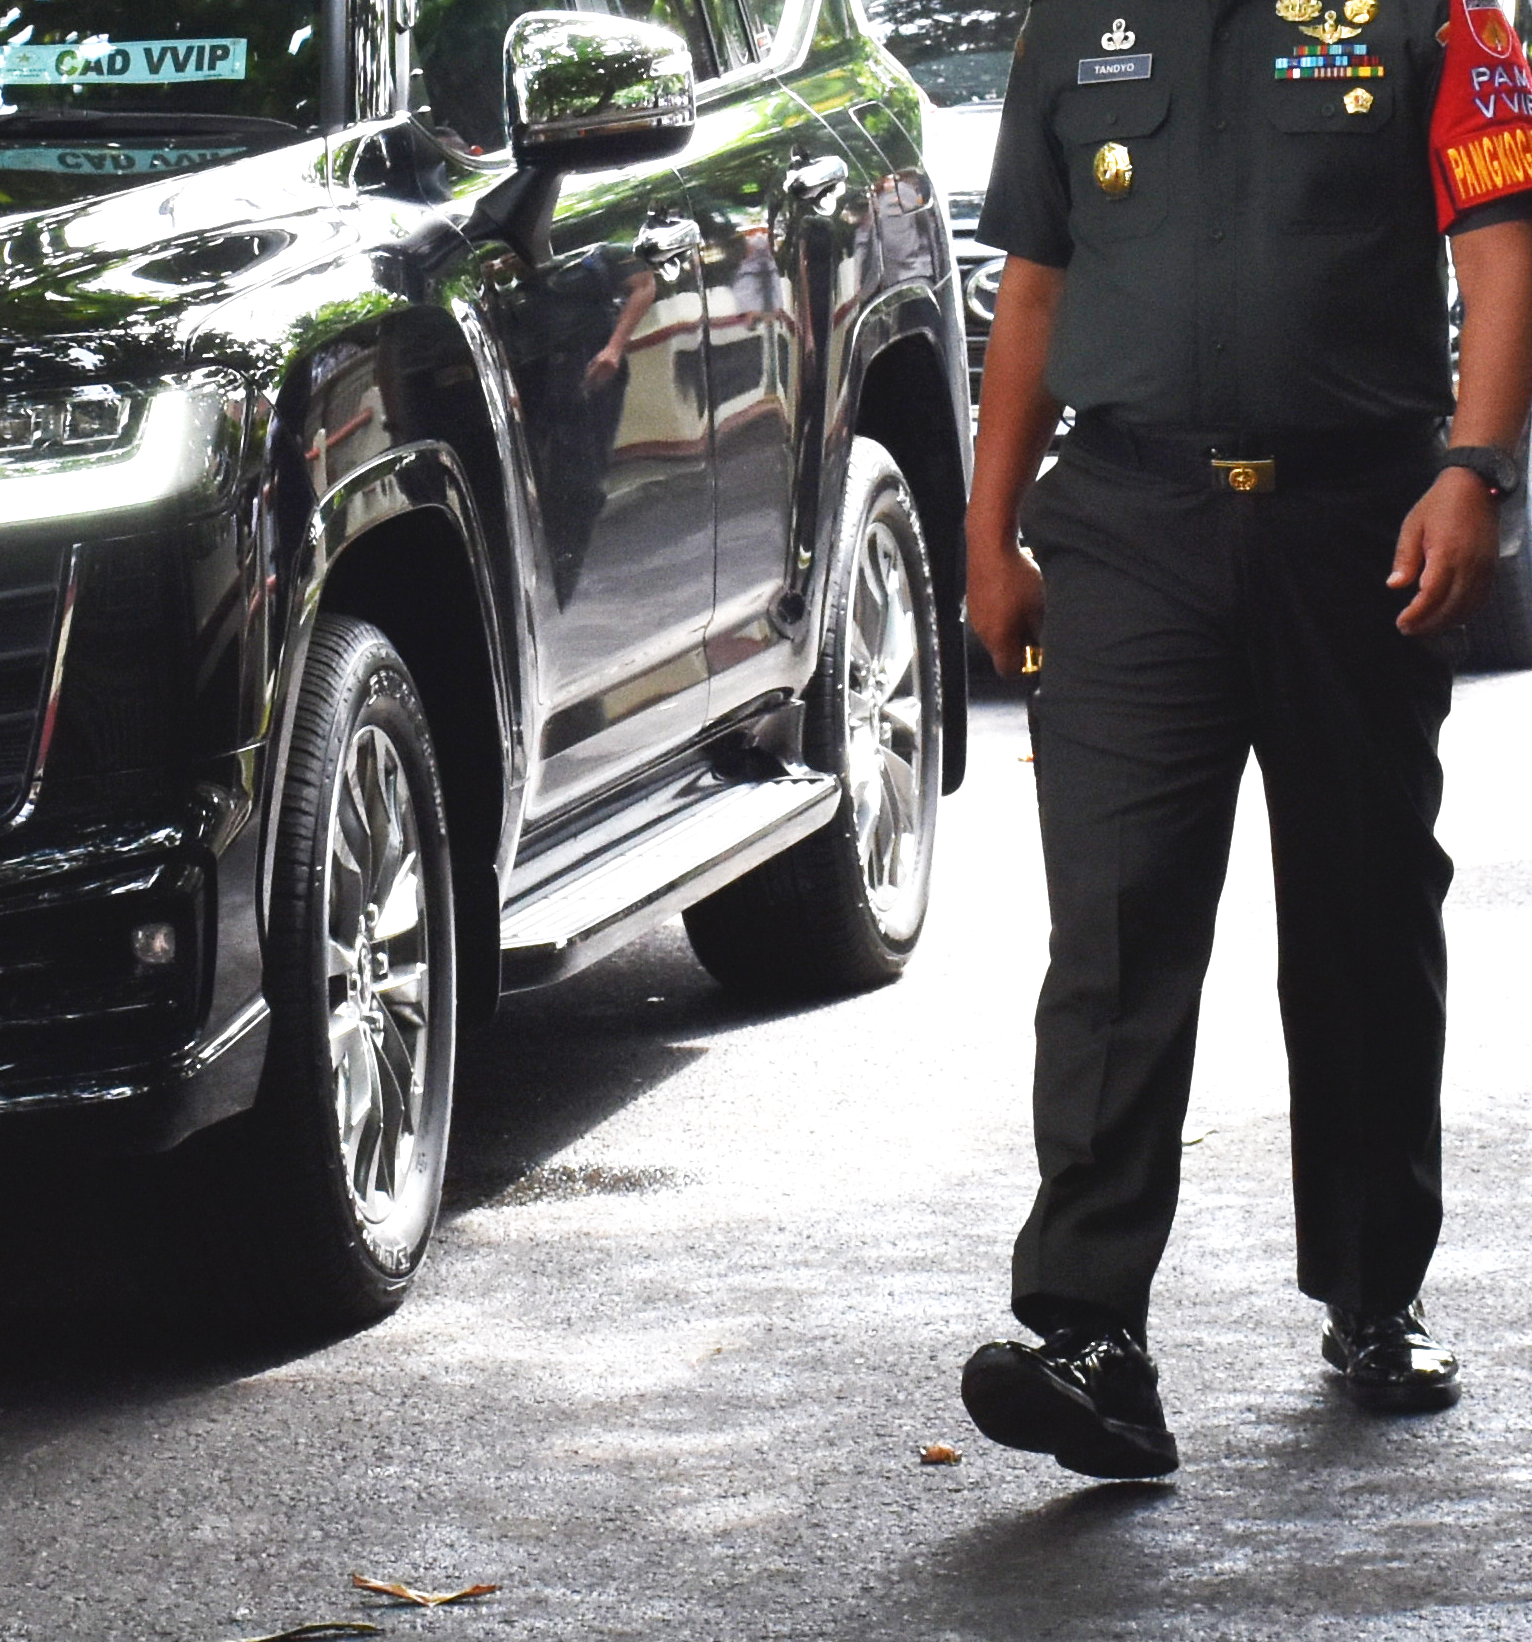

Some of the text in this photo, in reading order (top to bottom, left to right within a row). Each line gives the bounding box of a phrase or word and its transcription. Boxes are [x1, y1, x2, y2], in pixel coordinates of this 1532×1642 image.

[55, 44, 231, 76] CAD VVIP
[1094, 63, 1135, 75] TANDYO
[1471, 66, 1531, 91] PAM
